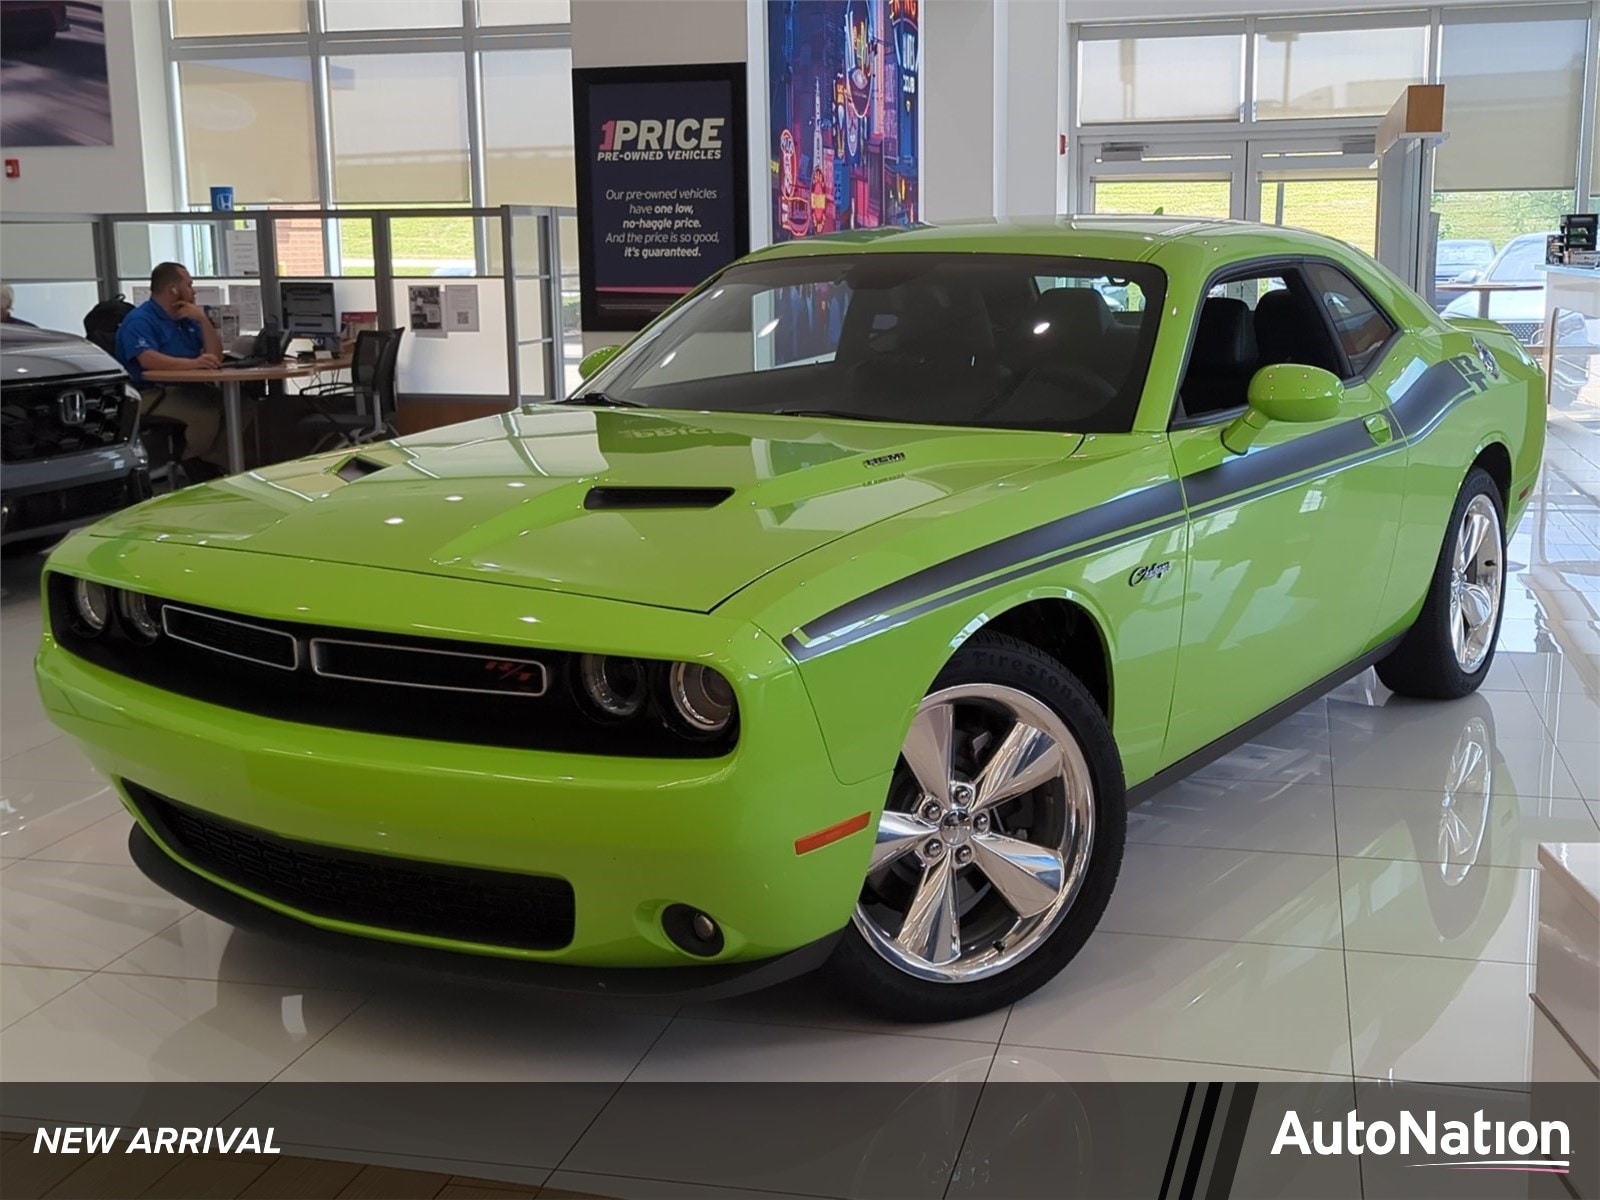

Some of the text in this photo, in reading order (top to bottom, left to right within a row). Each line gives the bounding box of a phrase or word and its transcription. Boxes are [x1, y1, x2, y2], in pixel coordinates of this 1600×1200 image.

[599, 118, 725, 150] 1PRICE
[597, 150, 721, 161] PRE-OWNED VEHICLES
[605, 188, 718, 201] Our pre-owned vehicles
[629, 203, 694, 214] have one low,
[623, 217, 702, 230] no-haggle price.
[605, 232, 720, 245] And the price is so good,
[624, 247, 702, 259] it's guaranteed.
[972, 651, 1084, 712] Firestone
